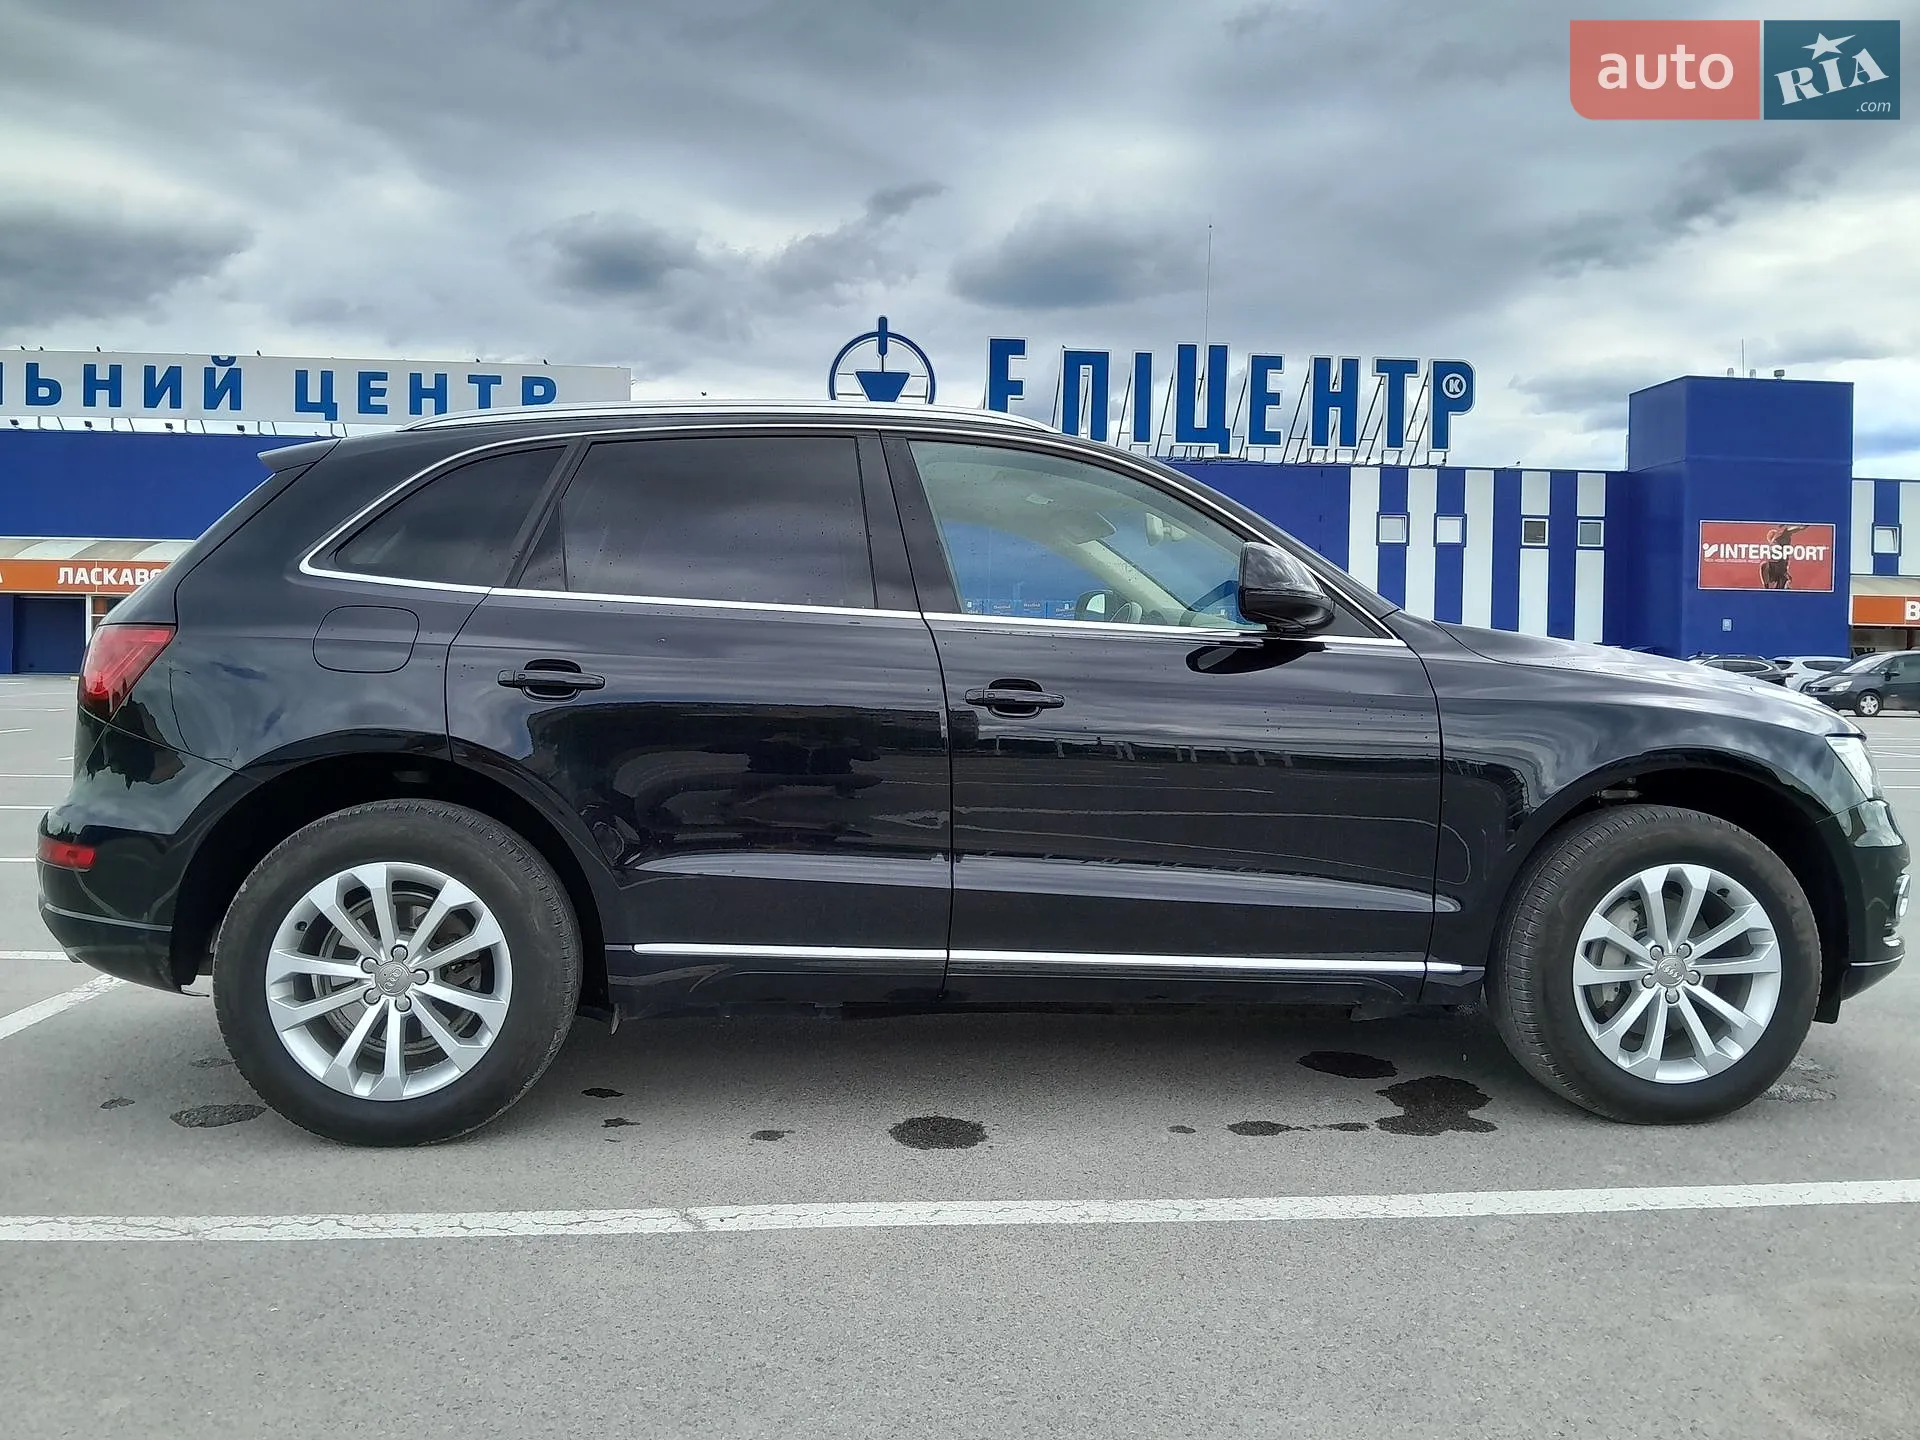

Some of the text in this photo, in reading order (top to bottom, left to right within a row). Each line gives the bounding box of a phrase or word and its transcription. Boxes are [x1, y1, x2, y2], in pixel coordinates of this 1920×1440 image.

[0, 355, 557, 421] ЬНИЙ ЦЕНТР
[1720, 543, 1826, 561] INTERSPORT
